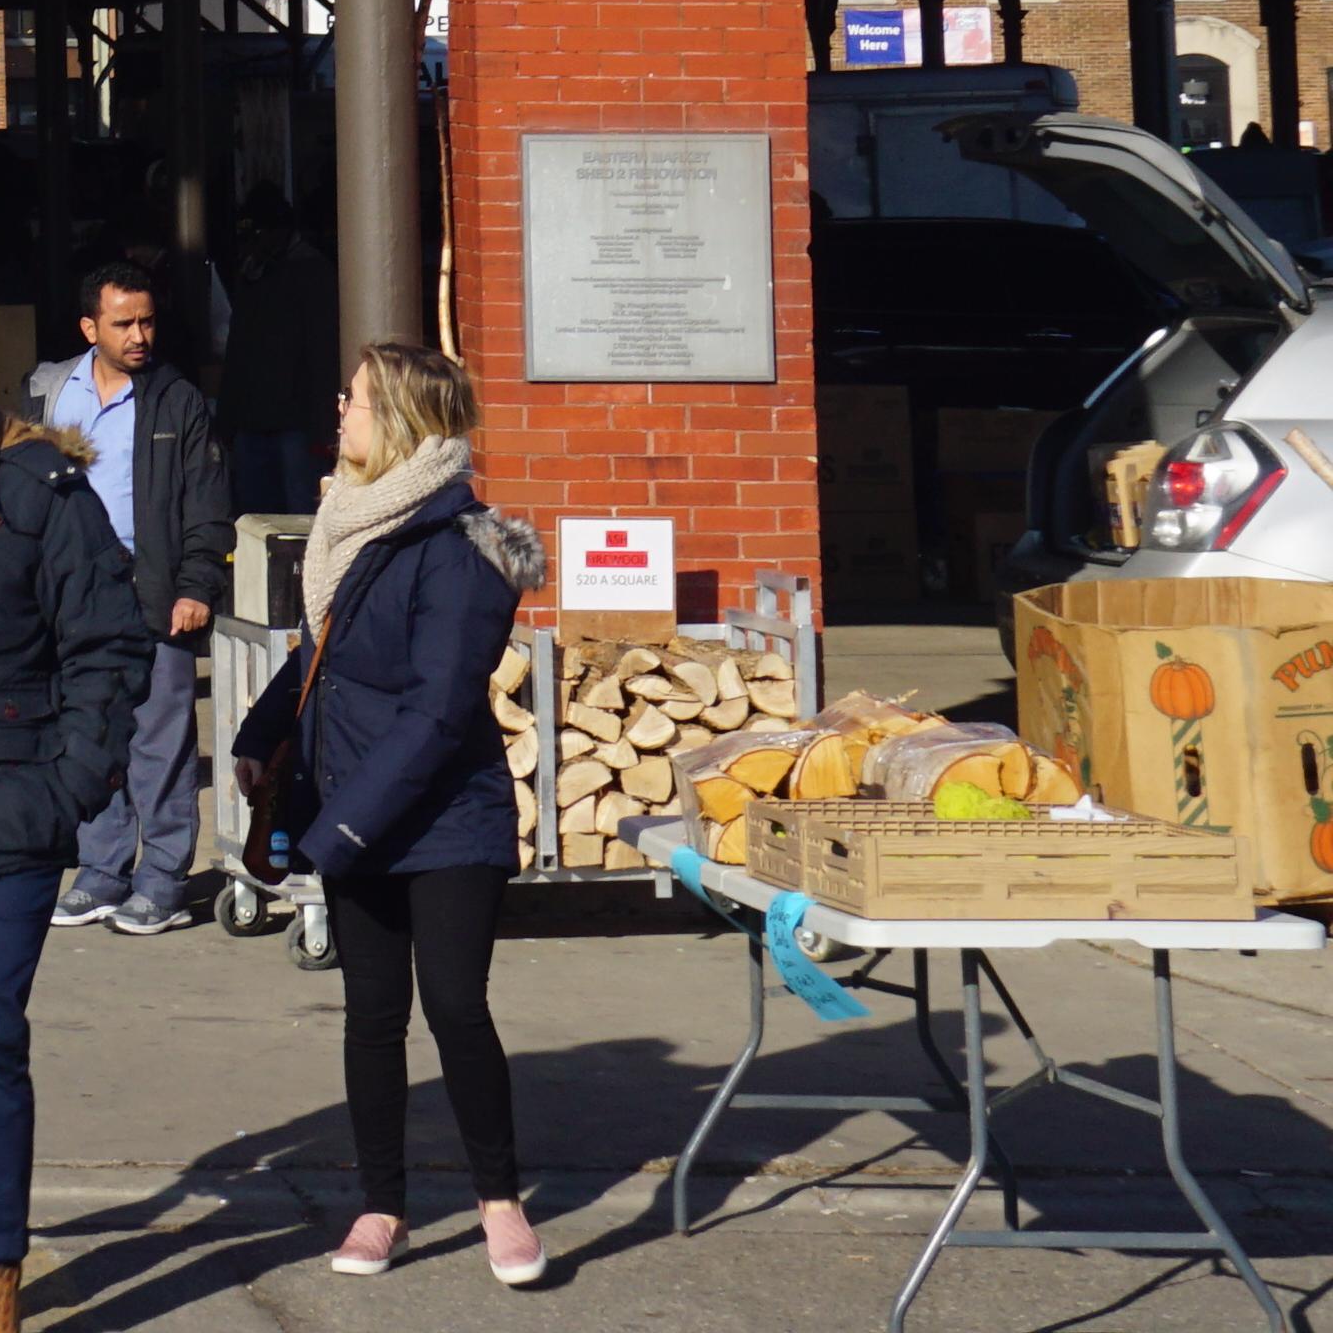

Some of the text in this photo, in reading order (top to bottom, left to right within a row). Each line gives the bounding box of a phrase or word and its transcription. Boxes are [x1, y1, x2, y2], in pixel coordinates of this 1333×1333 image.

[847, 23, 901, 35] Welcome
[859, 39, 889, 51] Here
[576, 572, 659, 586] $20 A SQUARE
